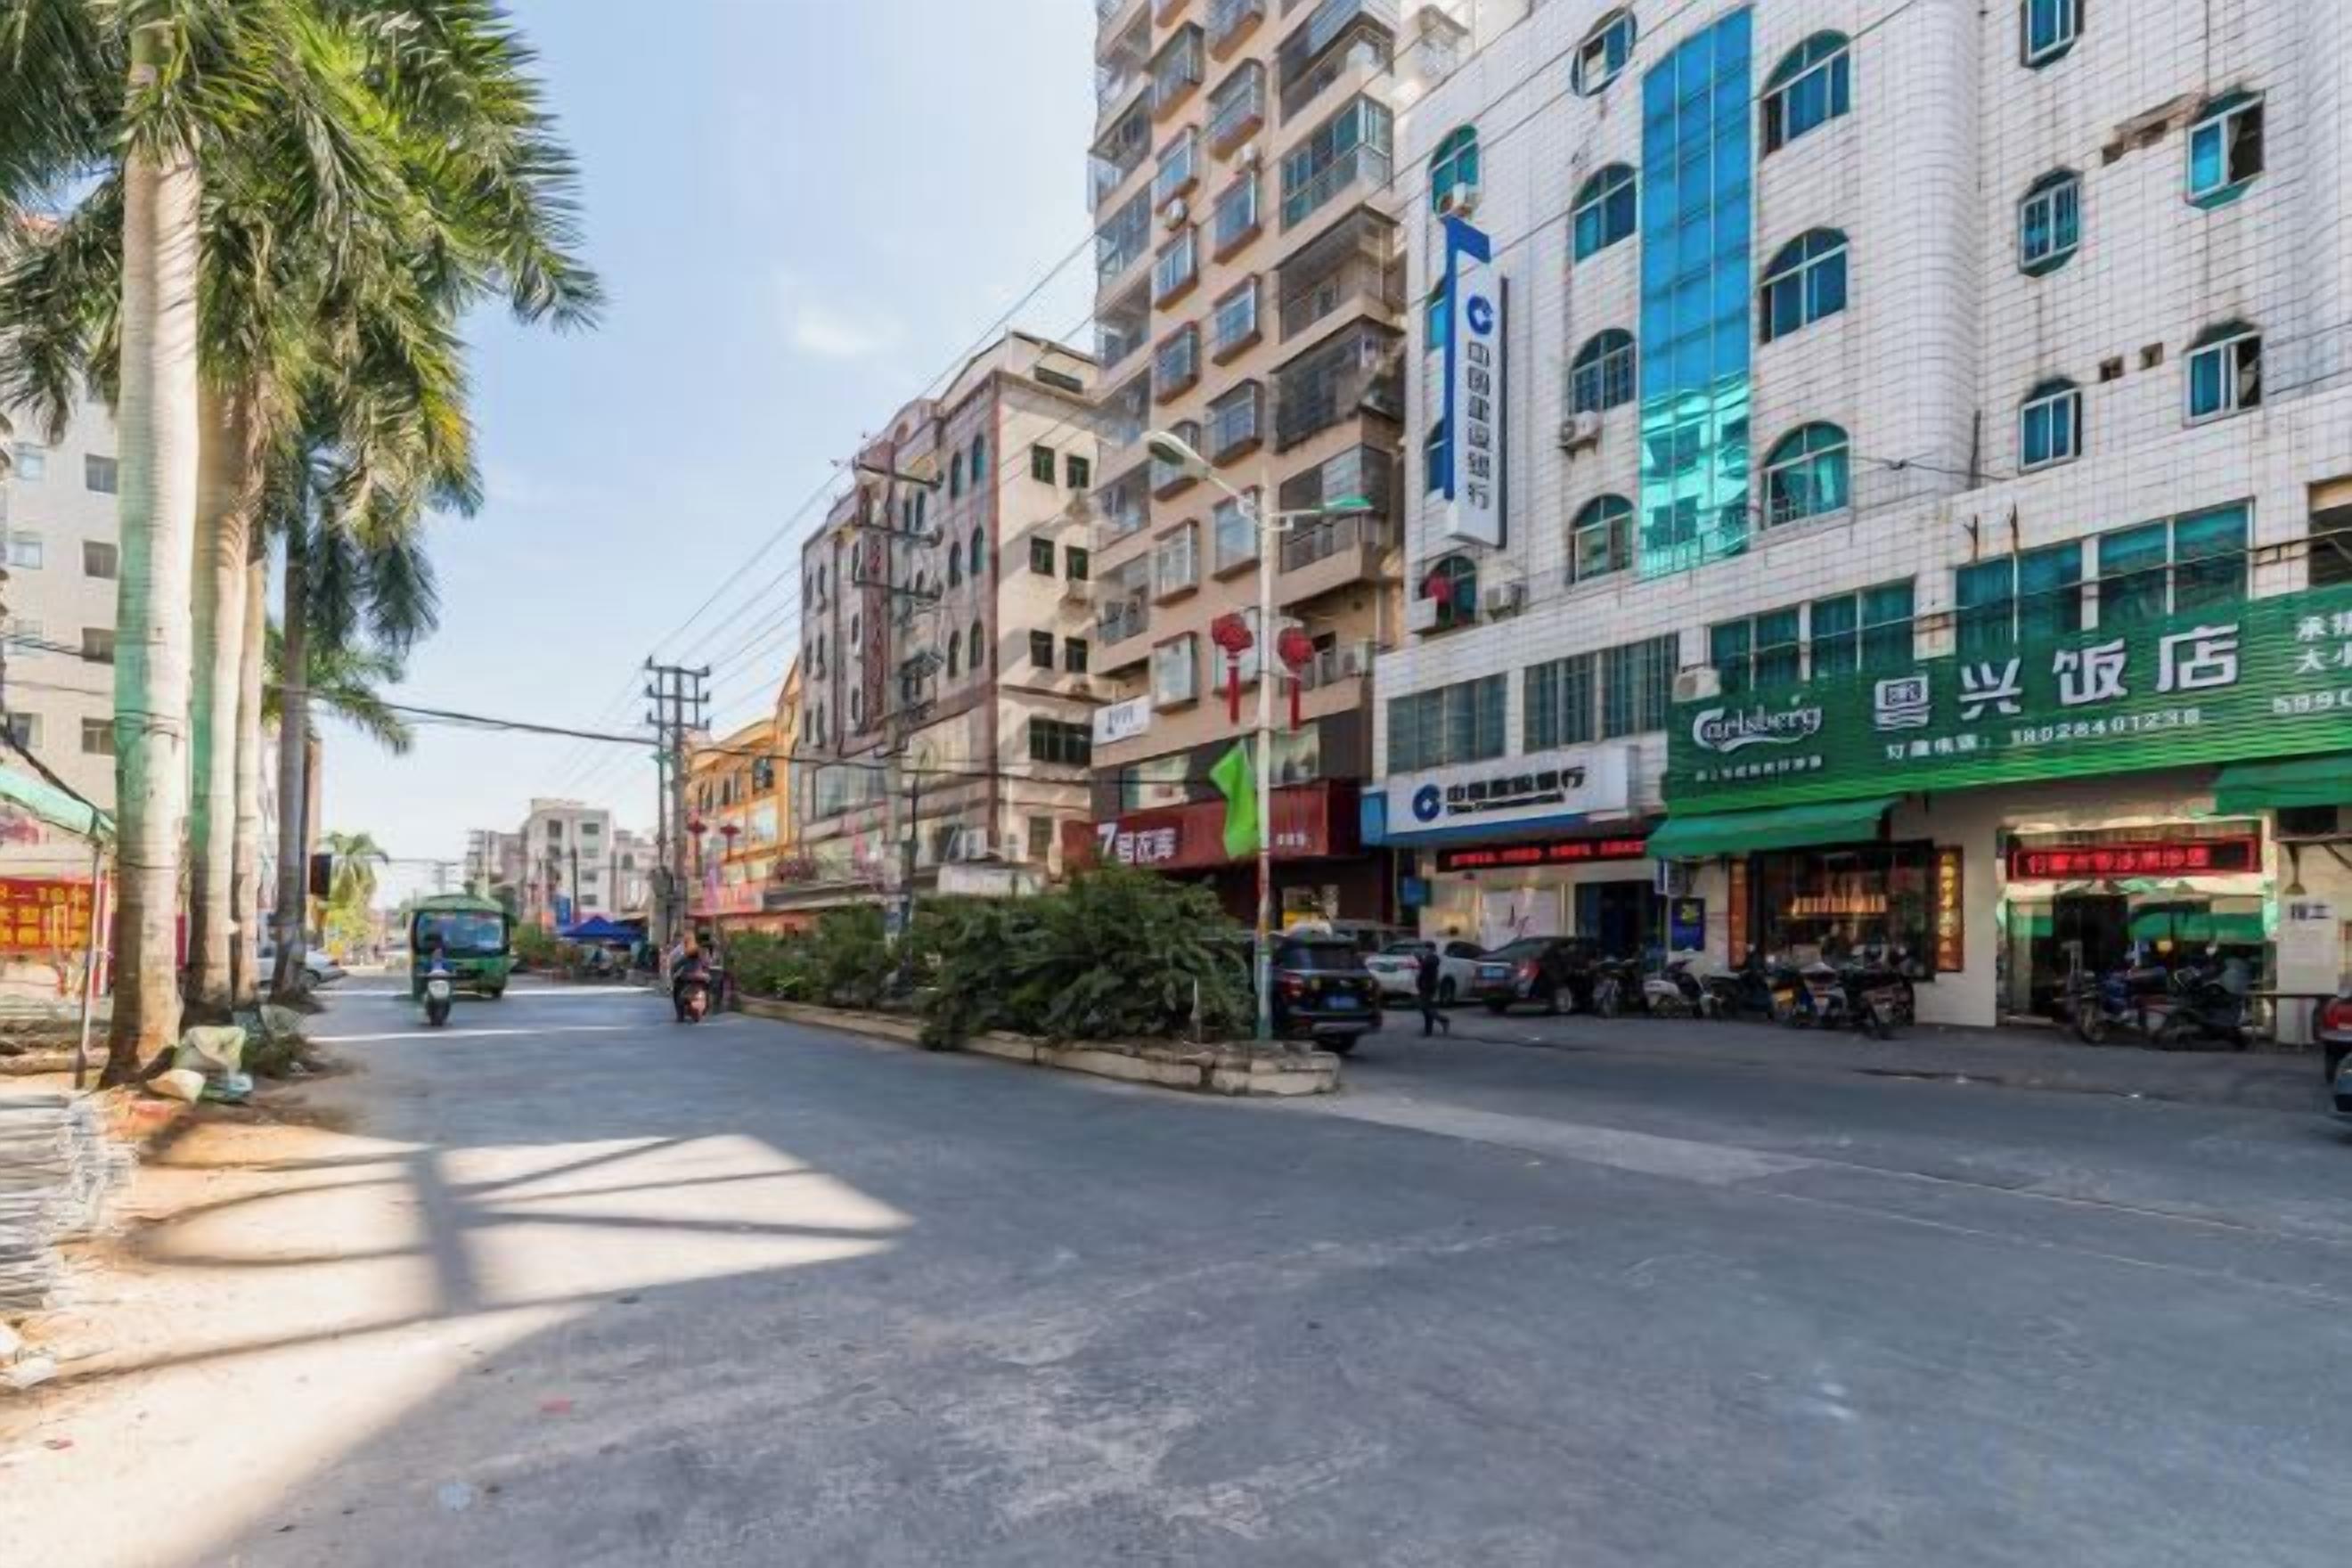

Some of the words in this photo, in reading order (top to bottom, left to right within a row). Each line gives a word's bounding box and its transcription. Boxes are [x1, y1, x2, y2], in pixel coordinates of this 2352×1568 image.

[1874, 624, 2239, 730] 粤兴饭店
[1693, 695, 1822, 752] Carlsberg
